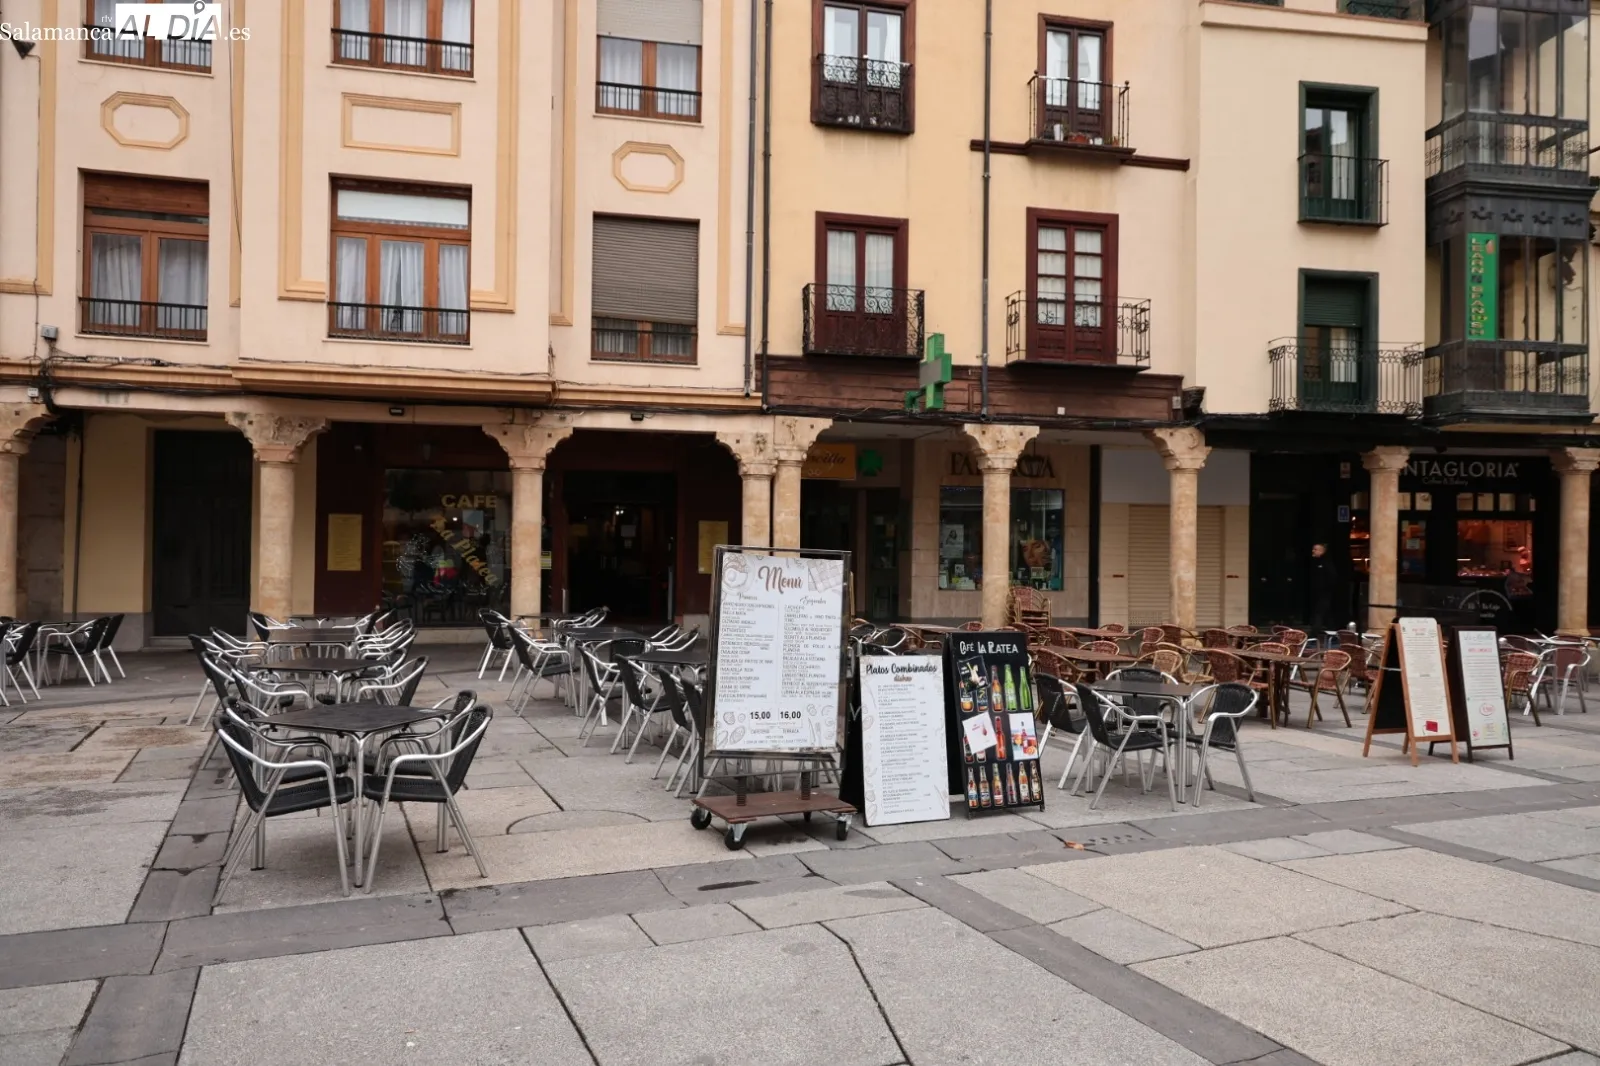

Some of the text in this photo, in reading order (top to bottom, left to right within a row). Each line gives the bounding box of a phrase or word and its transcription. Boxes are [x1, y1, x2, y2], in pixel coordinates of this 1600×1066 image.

[1400, 460, 1519, 477] NTAGLORIA
[758, 566, 803, 594] Menú
[866, 662, 938, 675] Platos Combinados
